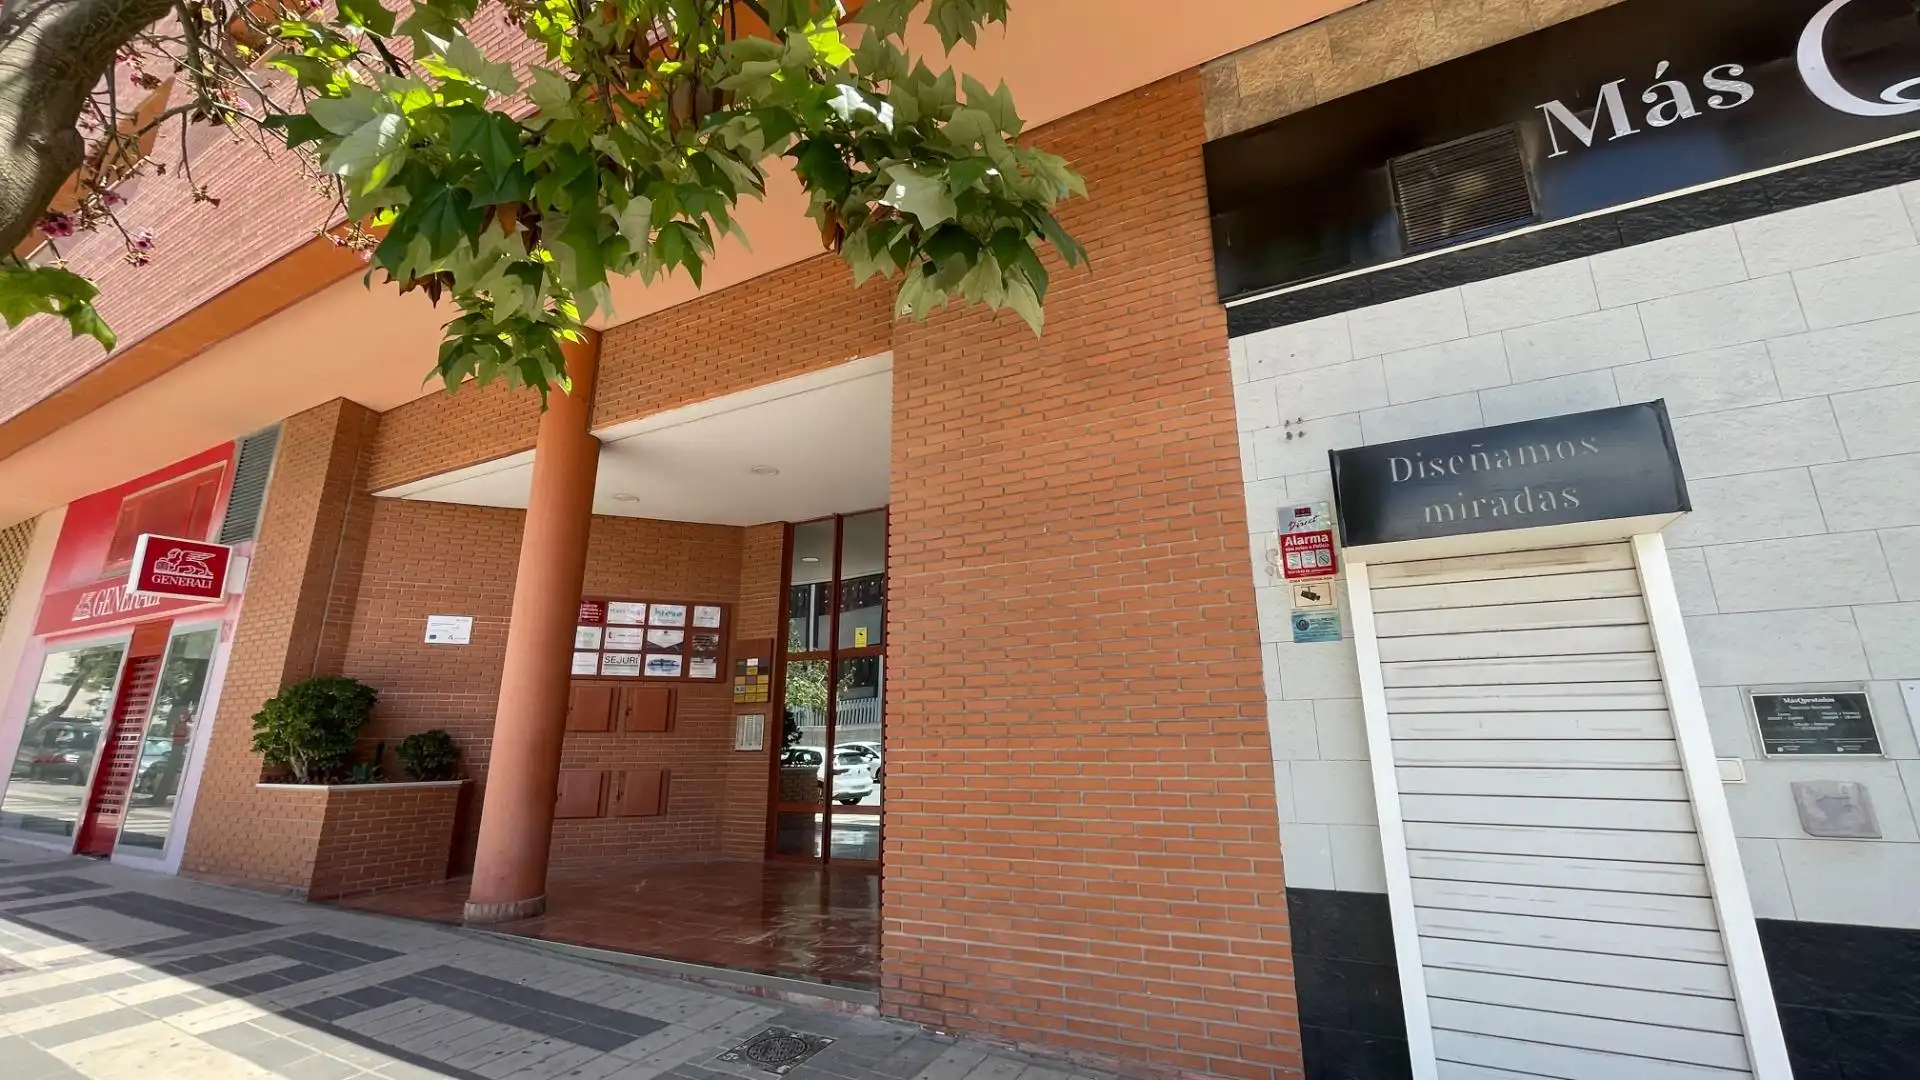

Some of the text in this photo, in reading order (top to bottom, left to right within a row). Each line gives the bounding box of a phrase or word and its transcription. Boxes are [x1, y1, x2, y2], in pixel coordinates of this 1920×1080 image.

[1535, 60, 1755, 159] Más
[1389, 436, 1600, 483] Diseñamos
[1425, 484, 1581, 524] miradas
[1285, 534, 1329, 546] Alarma
[151, 574, 213, 589] GENERALI
